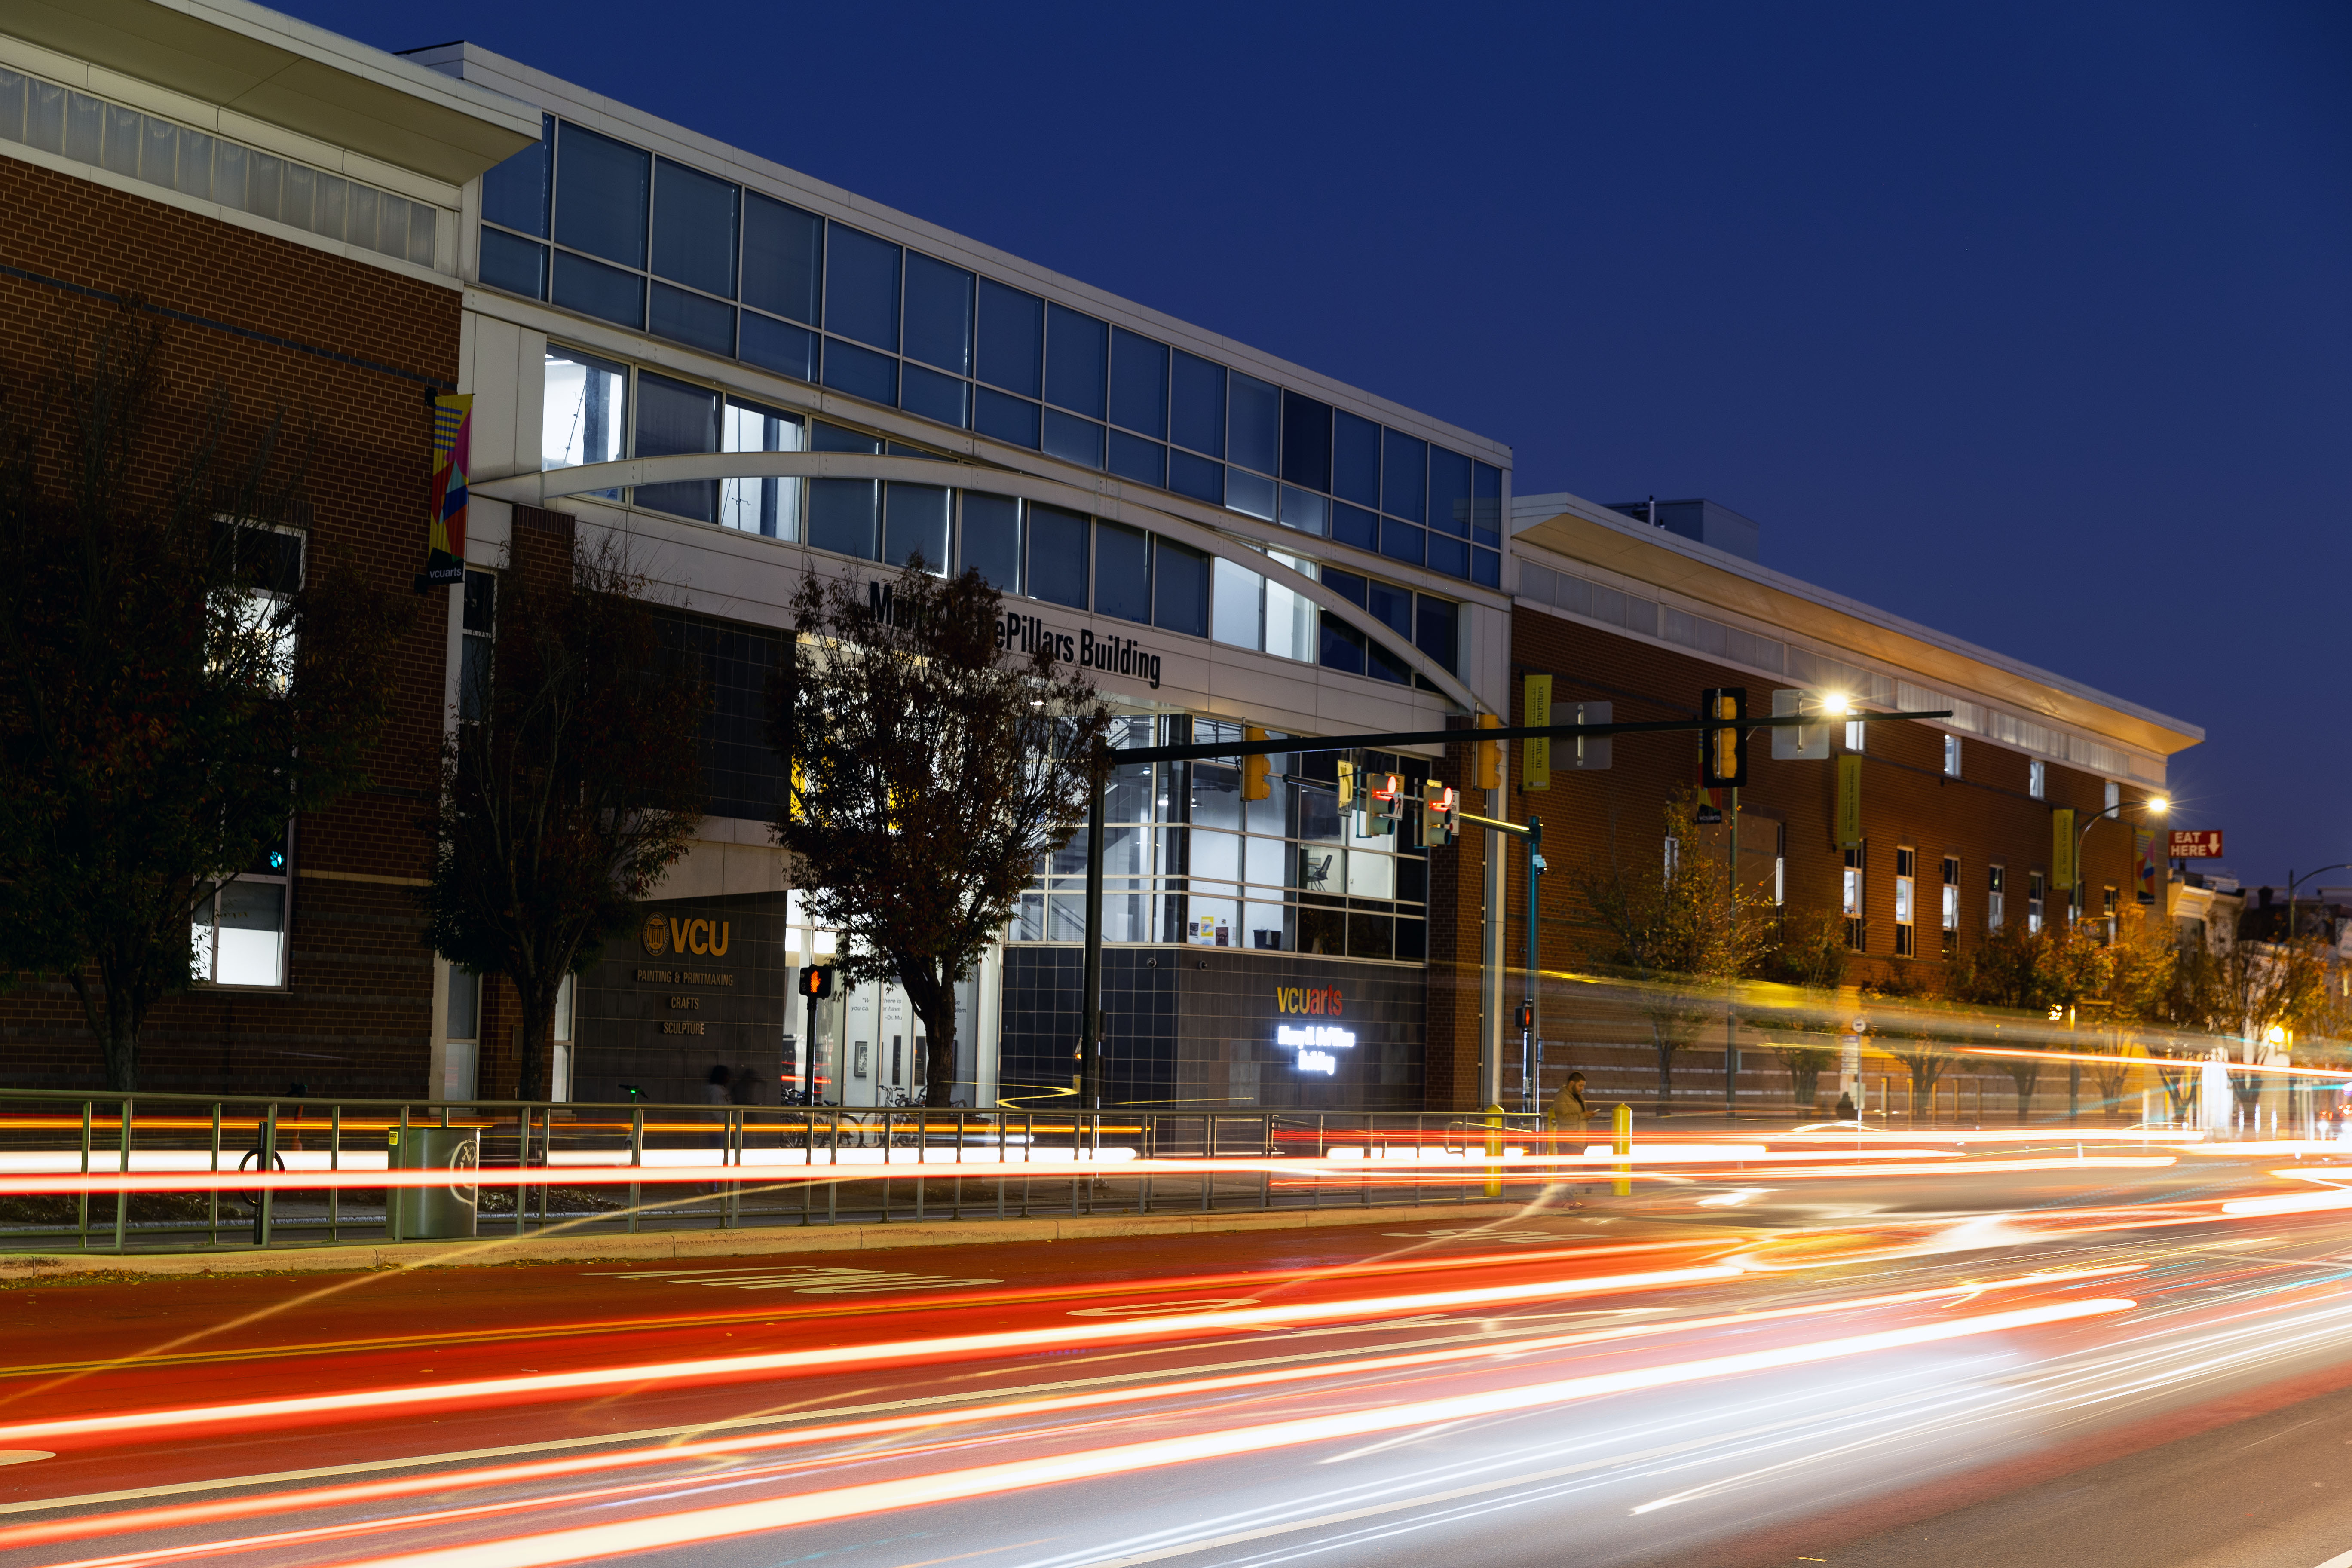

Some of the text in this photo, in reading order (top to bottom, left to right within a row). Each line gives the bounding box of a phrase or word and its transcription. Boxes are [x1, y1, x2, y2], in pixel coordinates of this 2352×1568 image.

[429, 567, 462, 579] vcuarts
[1080, 628, 1161, 690] Building
[1339, 801, 1351, 814] ONLY
[2174, 831, 2202, 843] EAT
[2171, 845, 2207, 856] HERE
[670, 917, 729, 956] VCU
[638, 969, 733, 986] PAINTING & PRINTMAKING
[671, 997, 699, 1010] CRAFTS
[1277, 984, 1343, 1016] vcuarts
[663, 1022, 704, 1035] SCULPTURE
